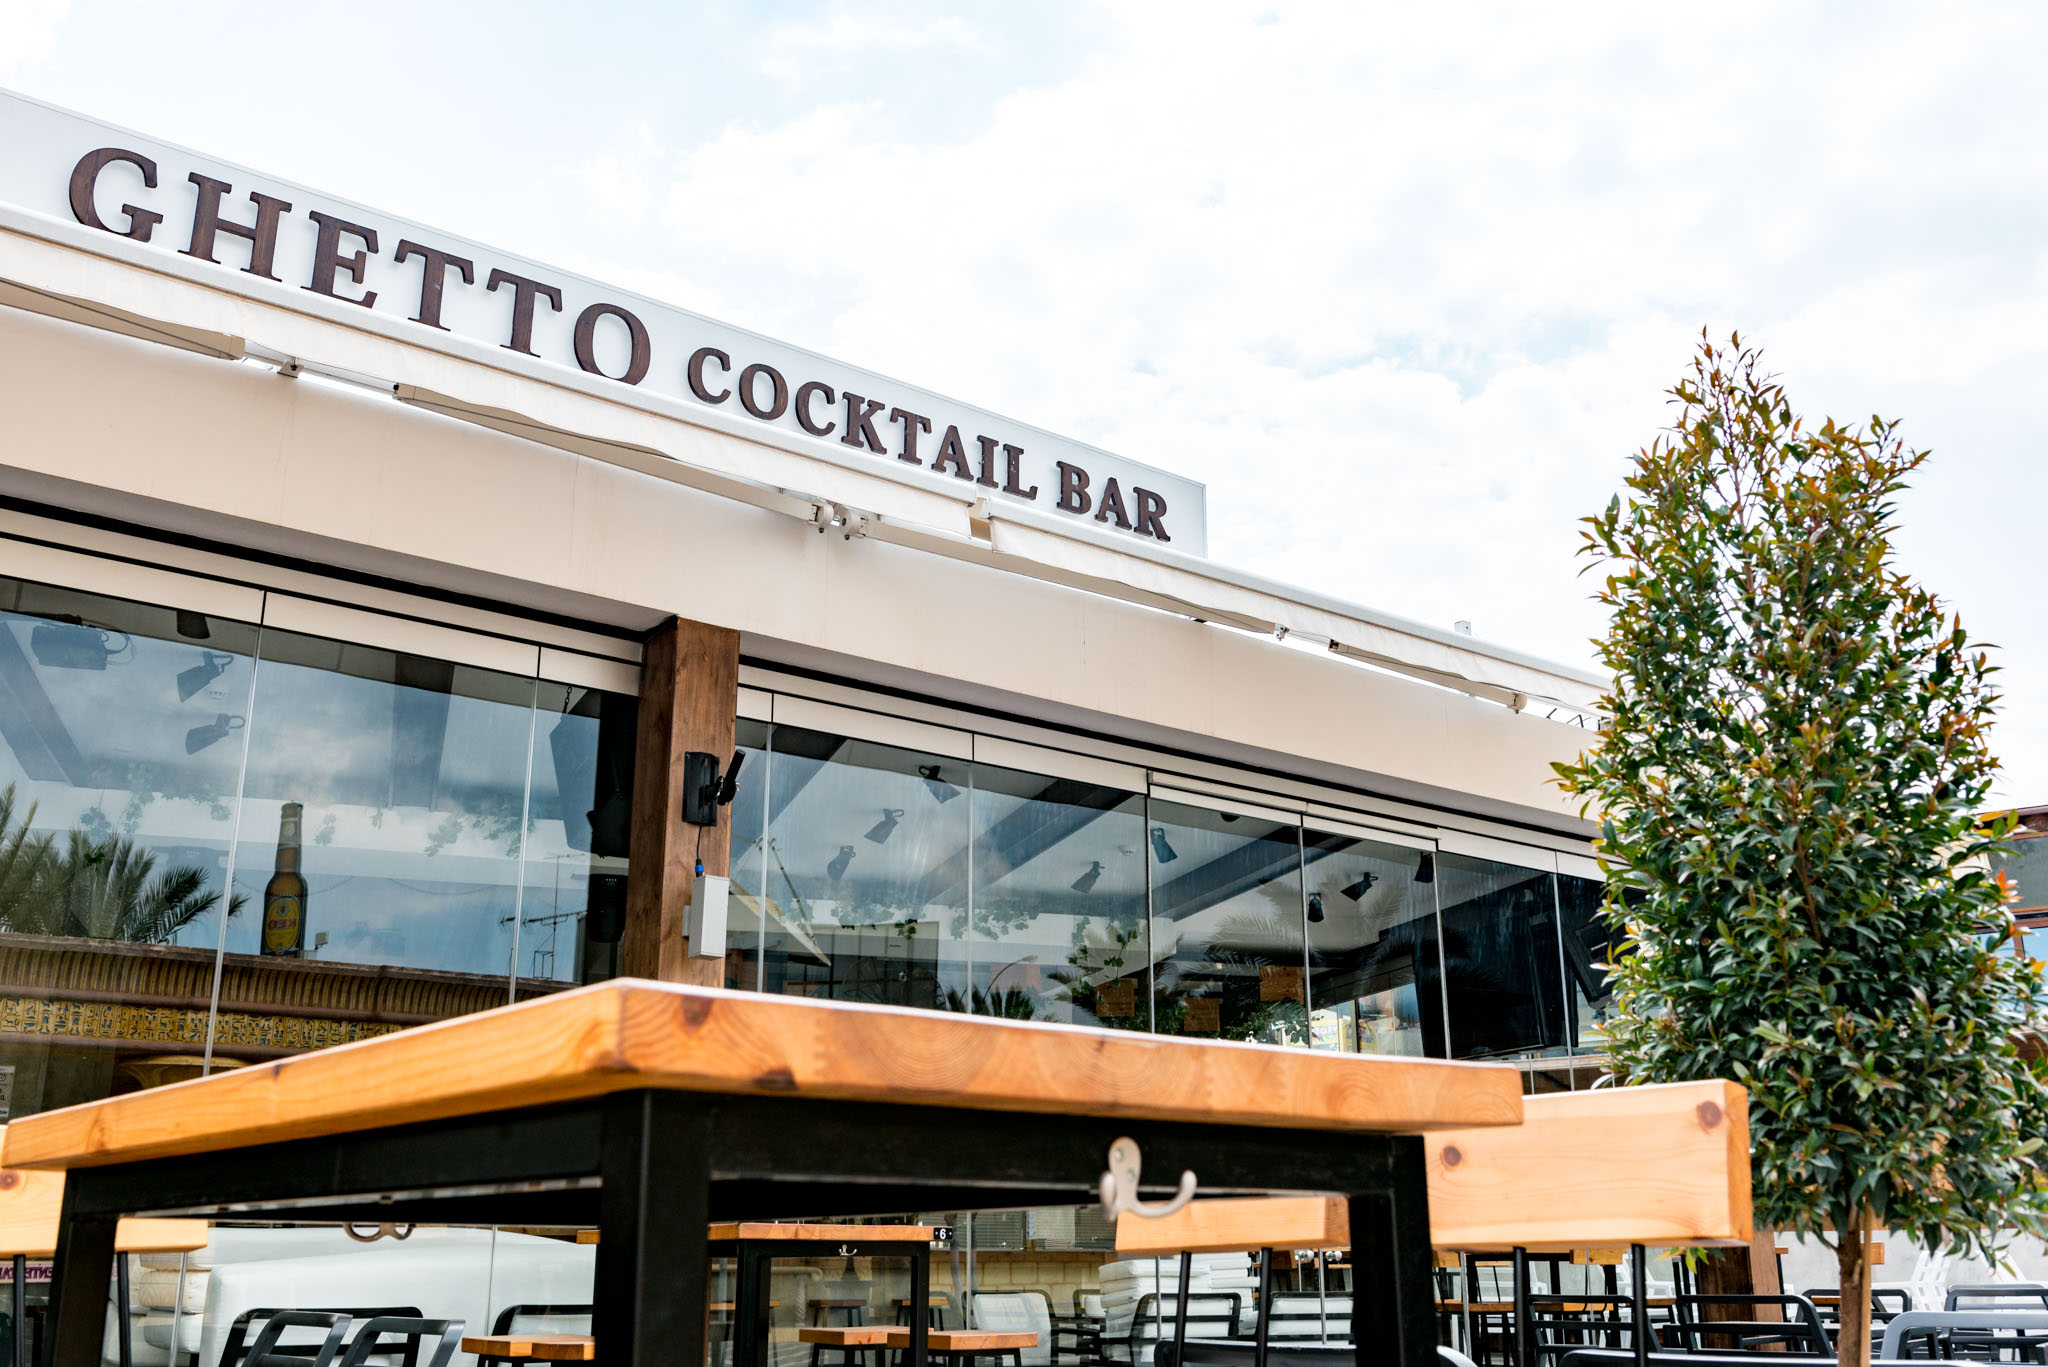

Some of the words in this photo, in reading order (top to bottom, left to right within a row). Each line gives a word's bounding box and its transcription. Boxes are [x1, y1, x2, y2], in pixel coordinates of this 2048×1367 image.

[69, 147, 651, 386] GHETTO
[687, 347, 1038, 501] COCKTAIL
[1056, 461, 1171, 542] BAR
[940, 1228, 946, 1240] 6
